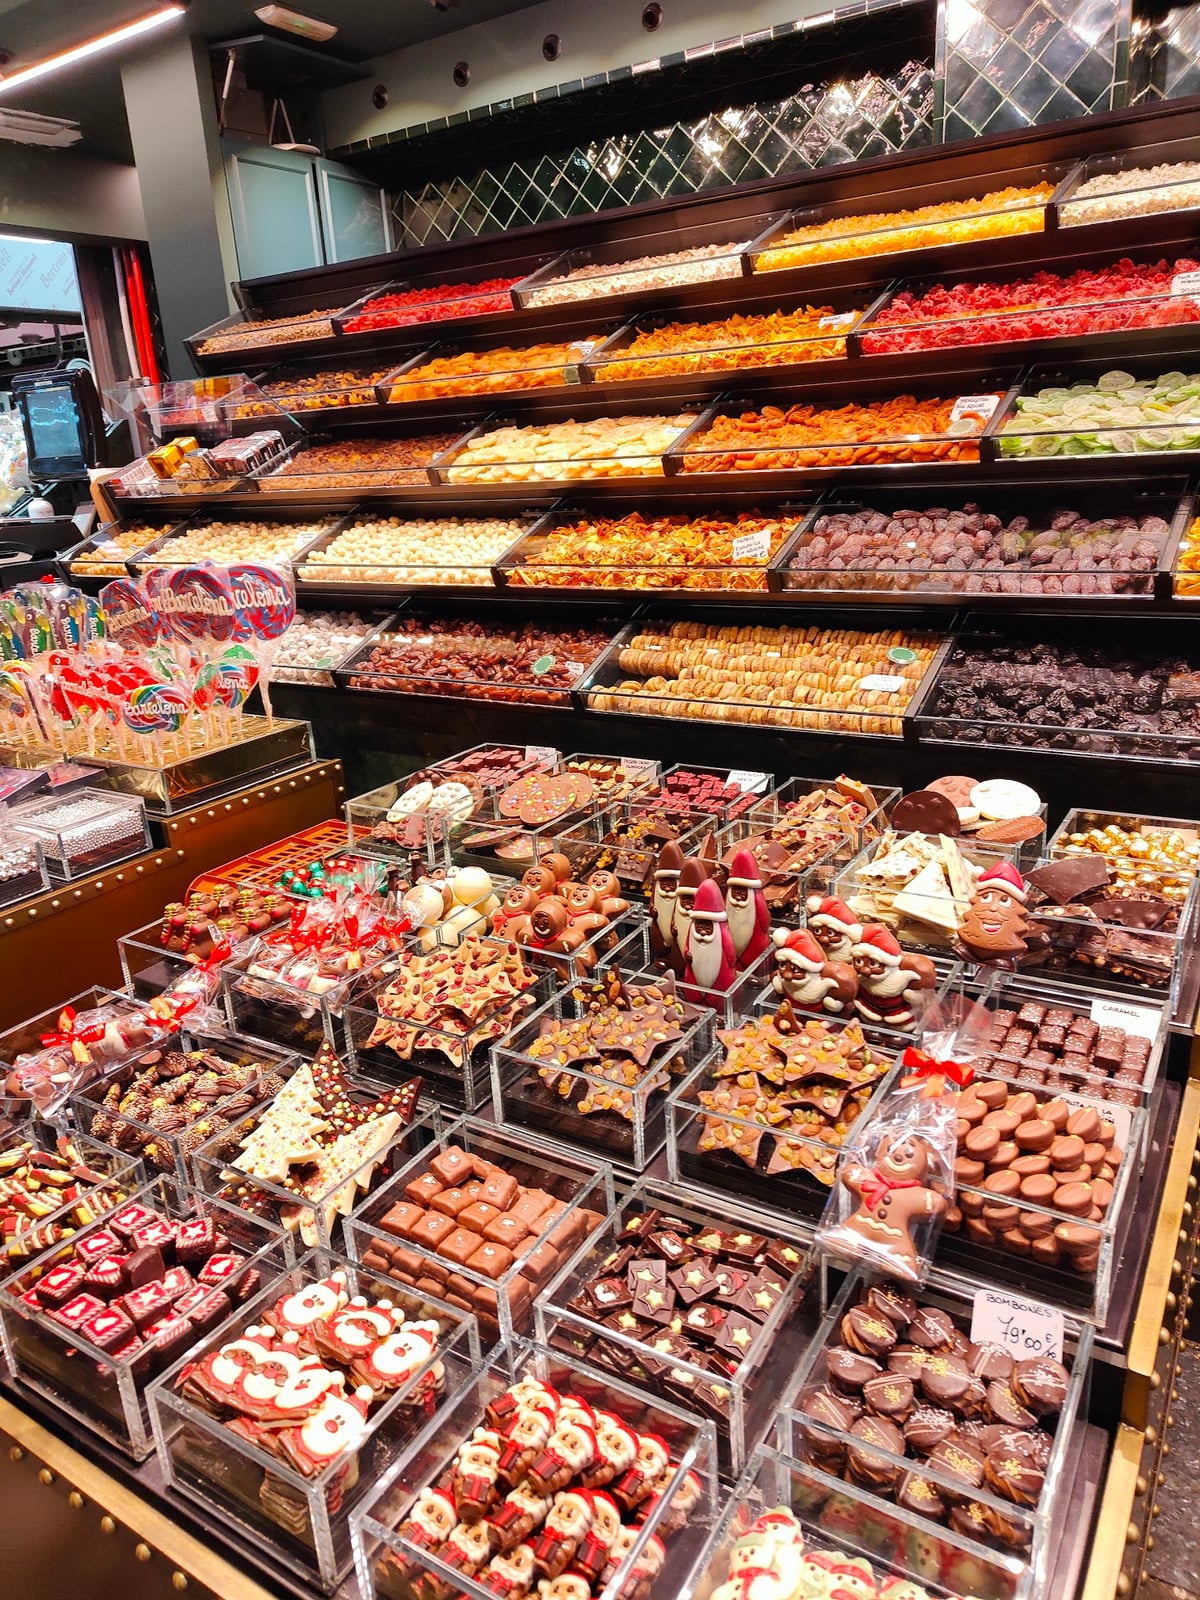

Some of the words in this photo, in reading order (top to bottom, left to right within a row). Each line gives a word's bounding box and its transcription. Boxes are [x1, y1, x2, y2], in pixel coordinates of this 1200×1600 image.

[161, 585, 235, 616] Barcelona
[124, 696, 188, 716] Barcelona
[1102, 1005, 1141, 1018] CARAMEL
[986, 1293, 1053, 1318] BOMBONES
